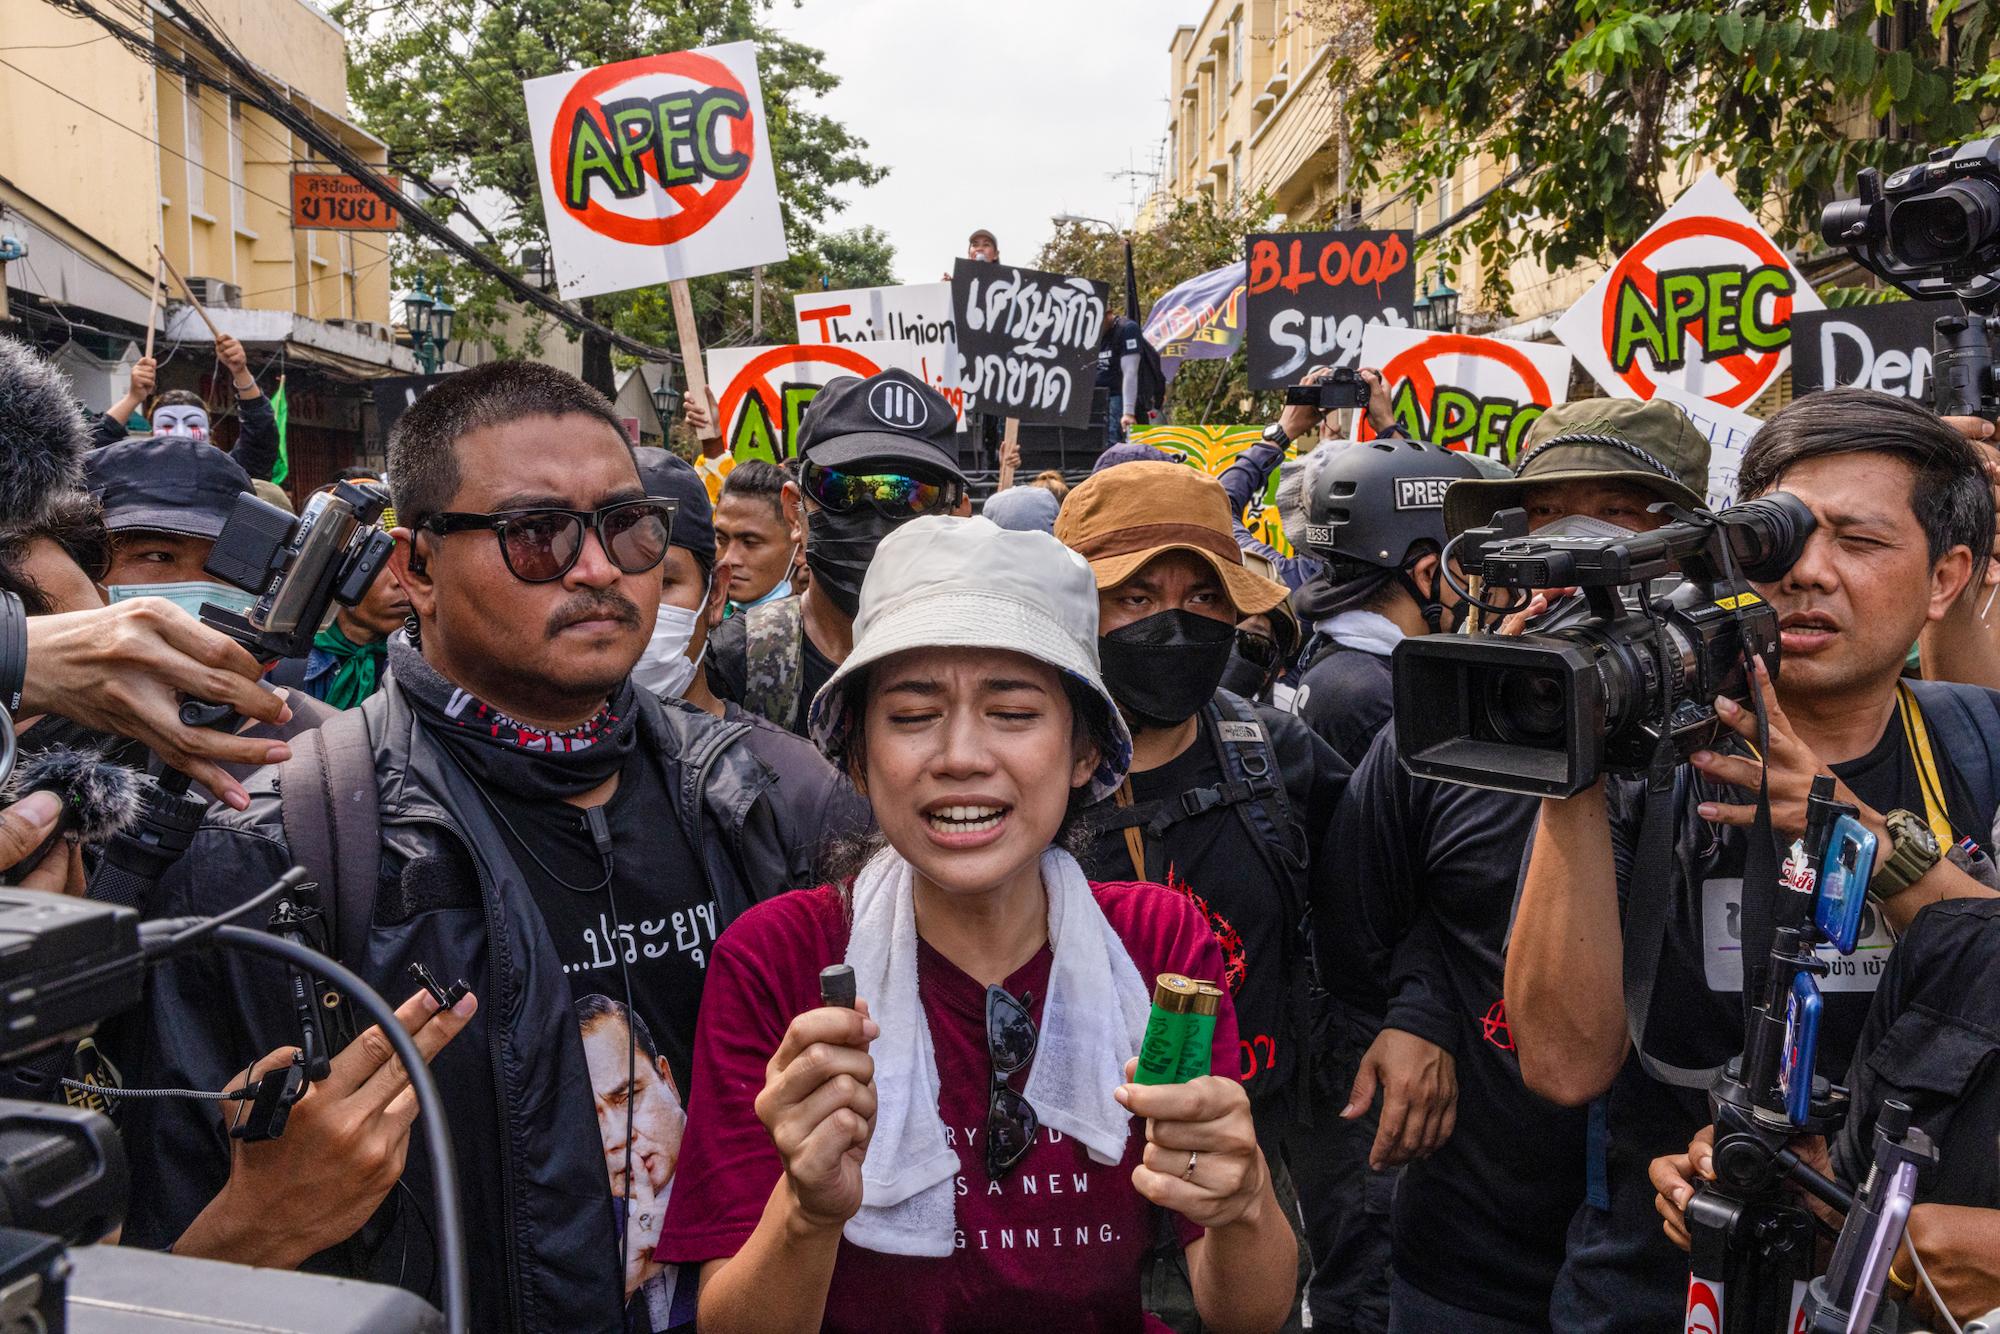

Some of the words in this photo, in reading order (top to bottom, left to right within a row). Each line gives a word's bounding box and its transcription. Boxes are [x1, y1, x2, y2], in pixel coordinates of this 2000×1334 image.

[566, 86, 749, 211] APEC
[1954, 160, 1982, 169] LUMIX
[301, 196, 392, 222] ขายยา
[1248, 232, 1408, 300] BLOOD
[889, 311, 956, 345] Union
[1611, 263, 1797, 374] APEC
[1401, 480, 1450, 506] PRES
[1023, 1173, 1088, 1195] NEW
